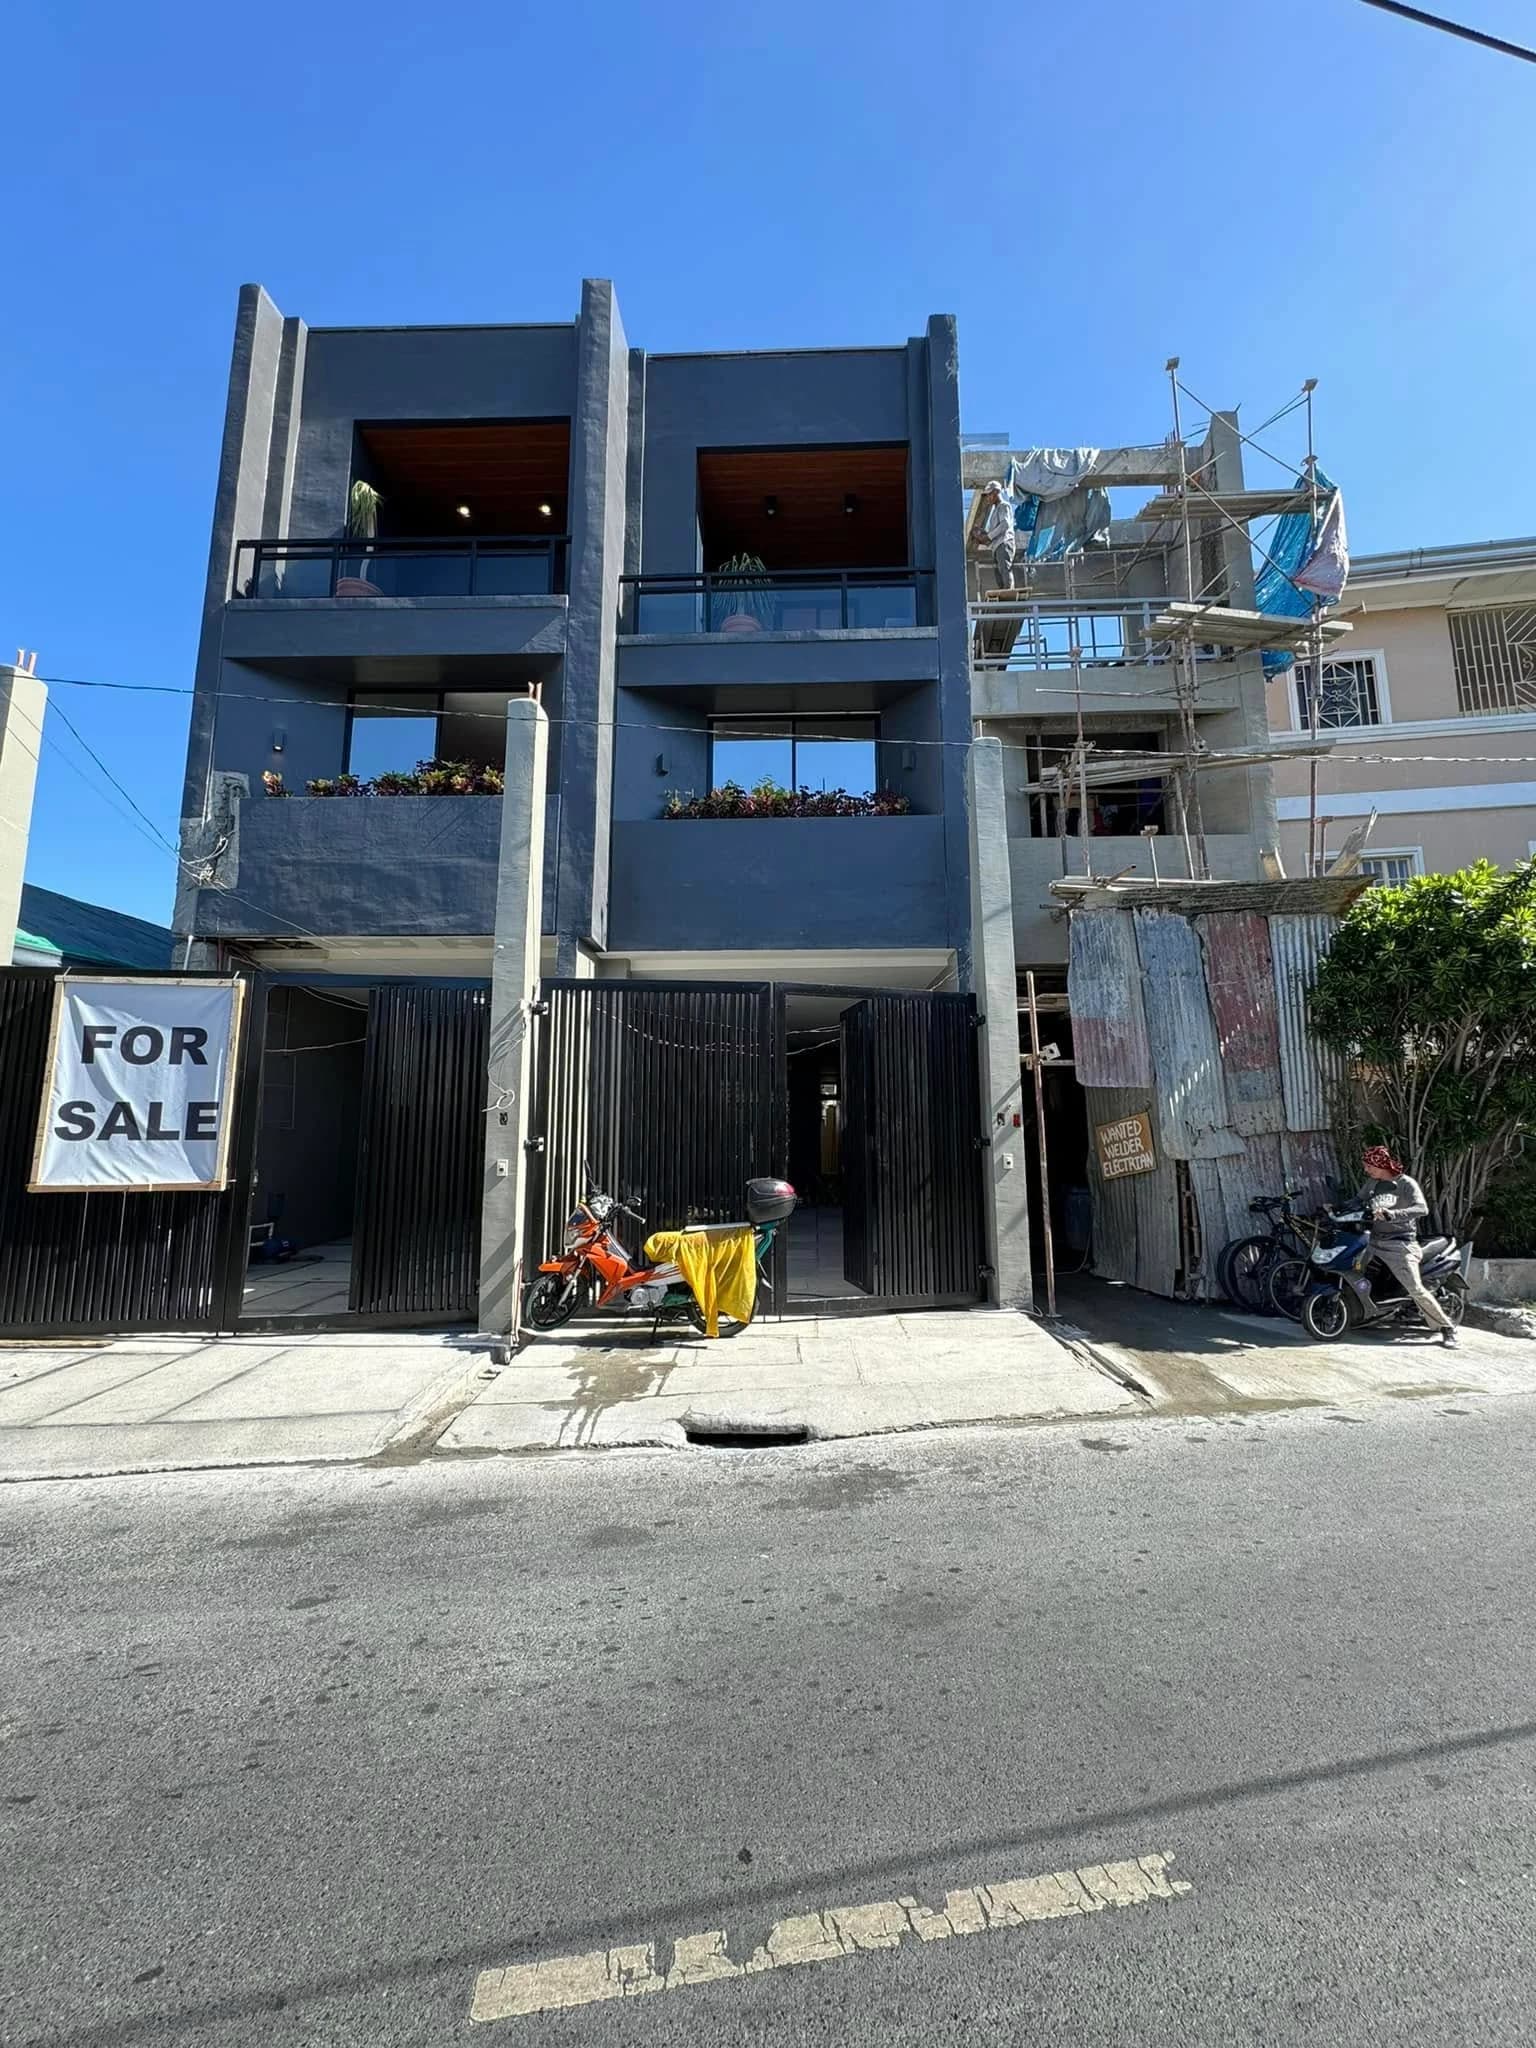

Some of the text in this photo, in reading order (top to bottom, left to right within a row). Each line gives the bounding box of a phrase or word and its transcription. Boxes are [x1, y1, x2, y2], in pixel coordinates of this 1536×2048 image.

[81, 1025, 208, 1066] FOR
[54, 1100, 220, 1142] SALE
[1100, 1119, 1143, 1146] WANTED
[1103, 1137, 1145, 1160] WELDER
